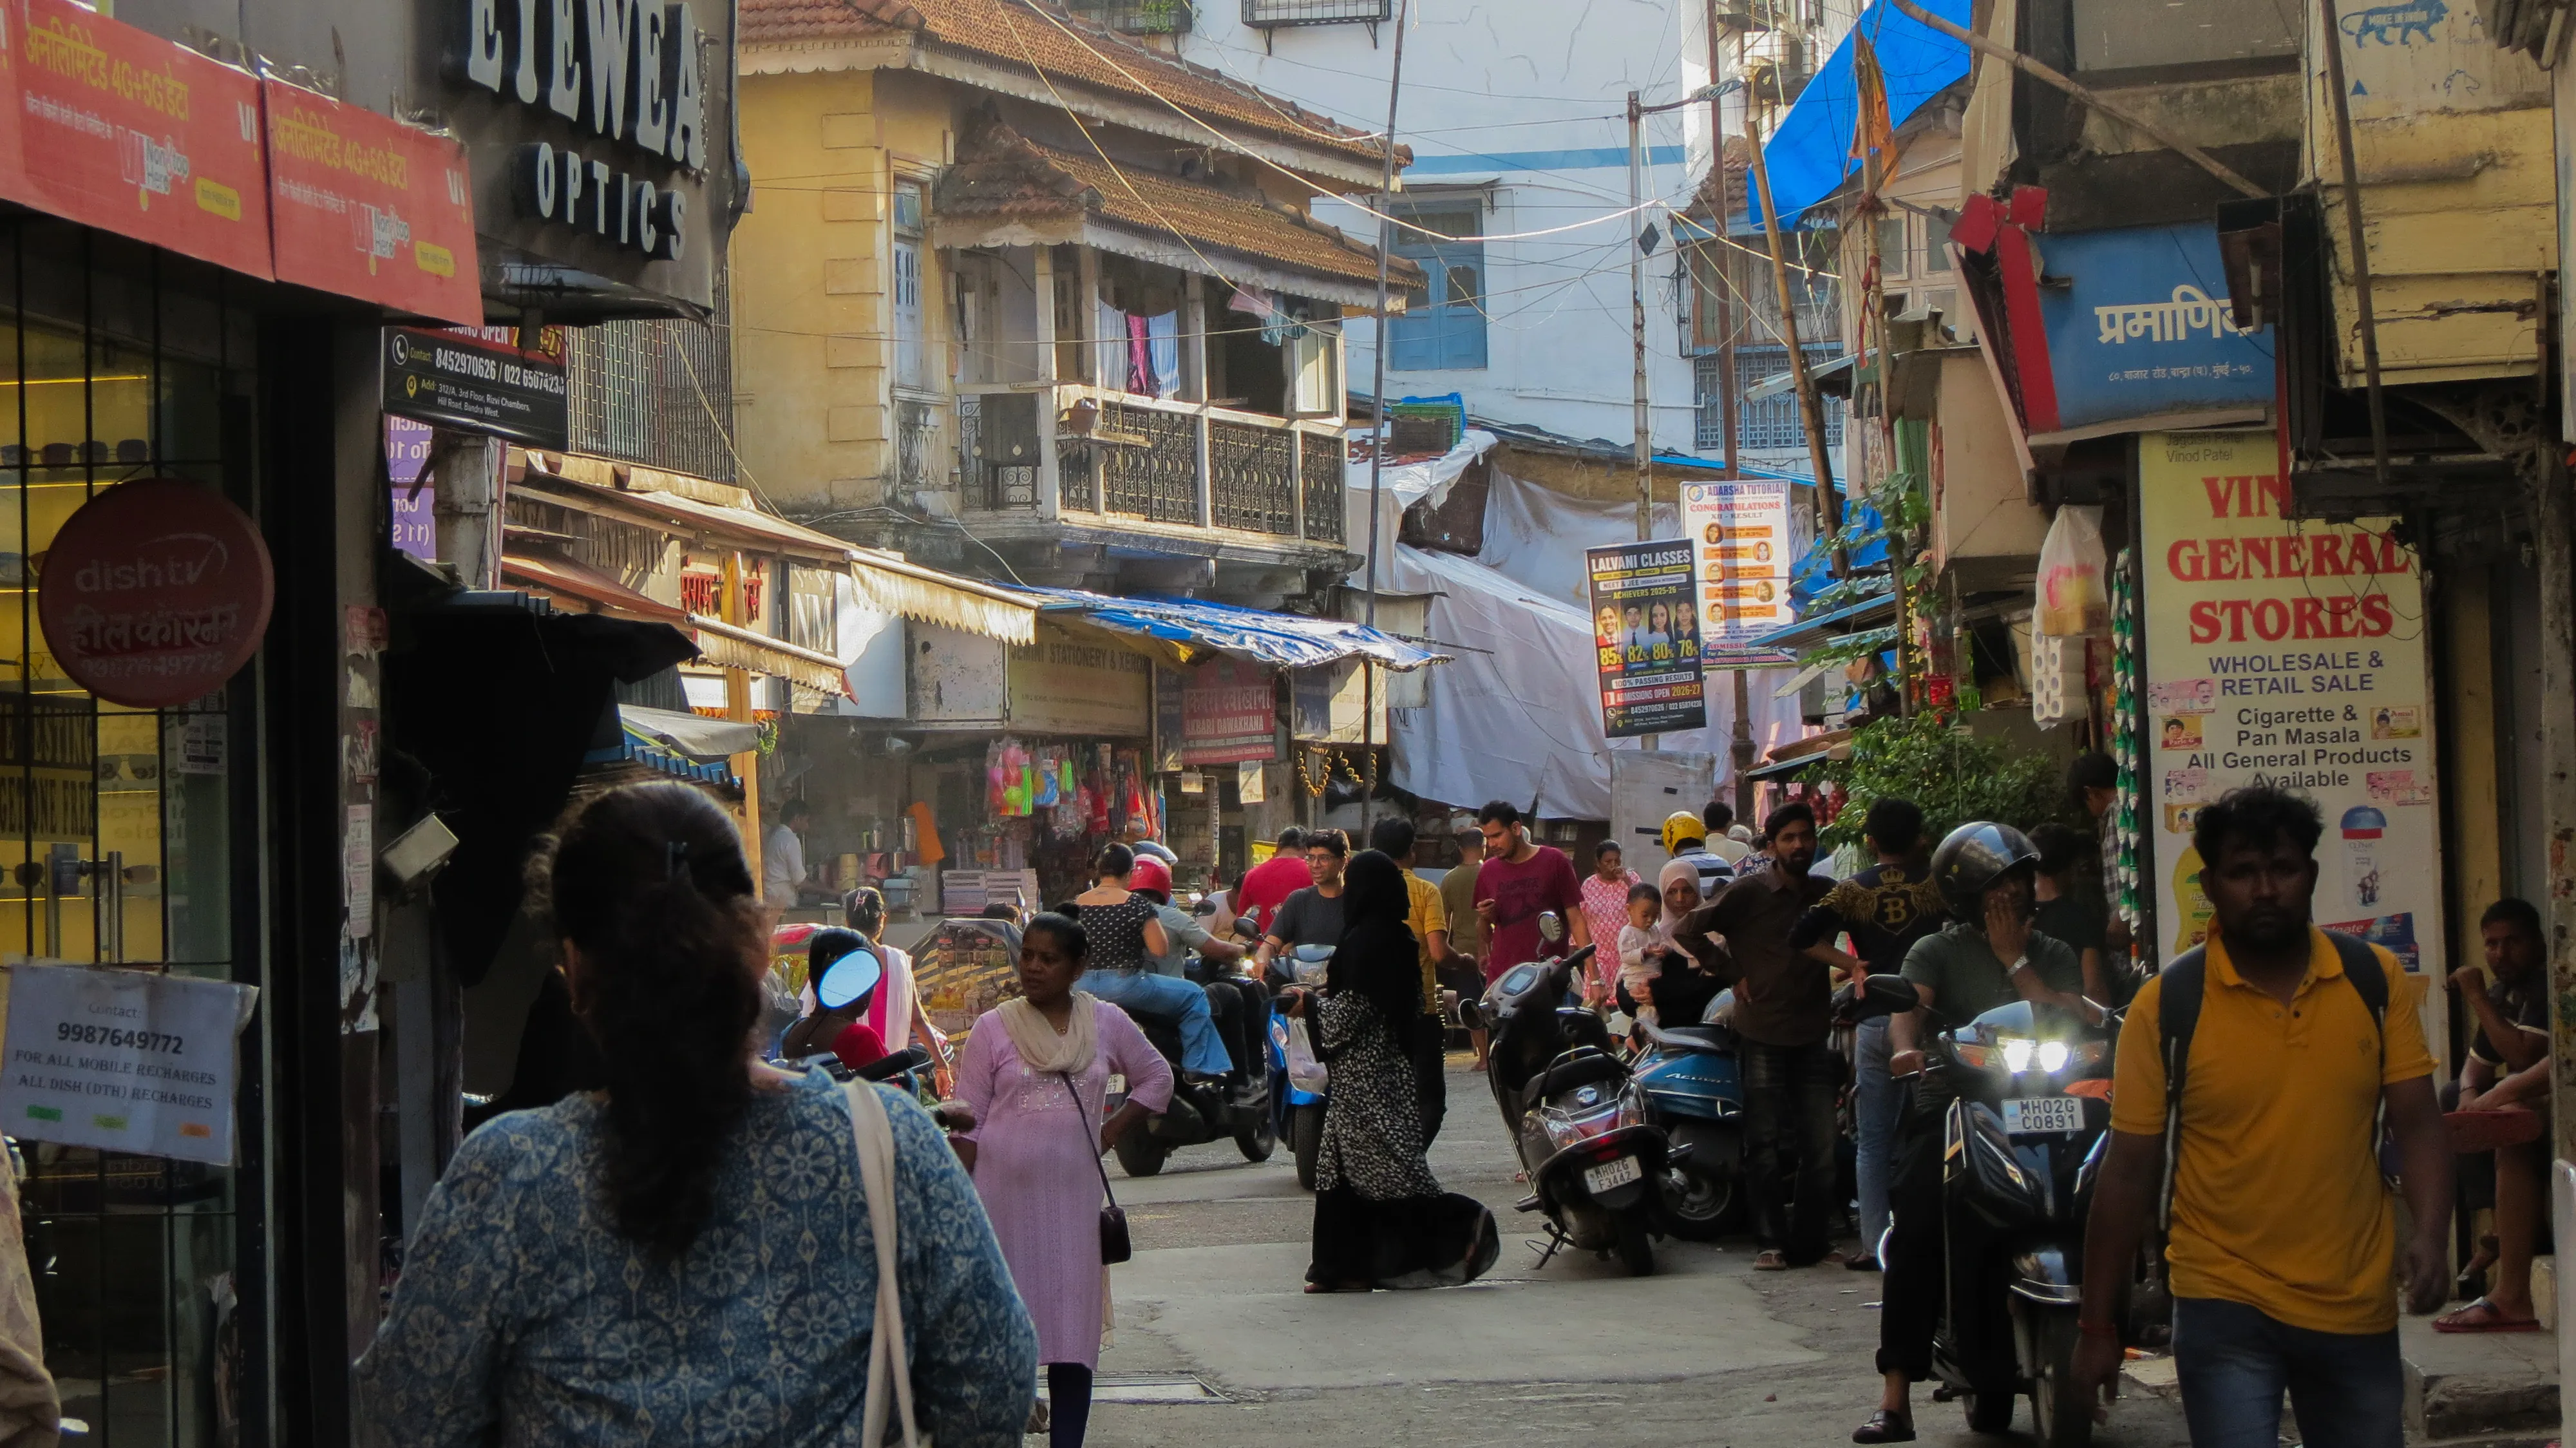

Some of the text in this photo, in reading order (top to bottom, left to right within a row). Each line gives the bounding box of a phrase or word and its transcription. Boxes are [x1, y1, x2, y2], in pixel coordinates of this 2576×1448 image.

[536, 142, 687, 260] OPTICS
[435, 347, 497, 381] 8452970626
[504, 363, 520, 386] 022
[2166, 448, 2233, 462] Vinod Patel
[1707, 483, 1785, 496] ADARSHA TUTORIAL
[1690, 500, 1781, 512] CONGRATULATIONS
[1591, 549, 1691, 572] LALVANI CLASSES
[2167, 532, 2411, 582] GENERAL
[1613, 587, 1649, 600] ACHIEVERS
[2190, 593, 2394, 645] STORES
[1048, 642, 1107, 670] STATIONERY
[1109, 649, 1116, 672] &
[1600, 646, 1624, 666] 85%
[1627, 644, 1649, 663] 82%
[1652, 642, 1674, 660] 80%
[1677, 639, 1699, 658] 78%
[2208, 651, 2384, 674] WHOLESALE &
[1615, 672, 1693, 688] 100% PASSING RESULTS
[2221, 674, 2374, 696] RETAIL SALE
[1616, 684, 1701, 703] ADMISSIONS OPEN 2026-27
[1184, 714, 1264, 736] AKBARI DAWAKHANA
[2237, 705, 2358, 729] Cigarette &
[2237, 727, 2360, 747] Pan Masala
[2188, 746, 2412, 769] All General Products
[2253, 770, 2349, 790] Available
[1883, 897, 1908, 924] B
[88, 1003, 141, 1019] Contact:
[57, 1021, 184, 1055] 9987649772
[14, 1049, 217, 1086] FOR ALL MOBILE RECHARGES
[18, 1074, 213, 1109] ALL DISH (DTH) RECHARGES
[2020, 1098, 2076, 1116] MH02G
[2022, 1114, 2076, 1130] C0891
[1595, 1159, 1630, 1179] MH02G
[1598, 1170, 1633, 1190] F3442
